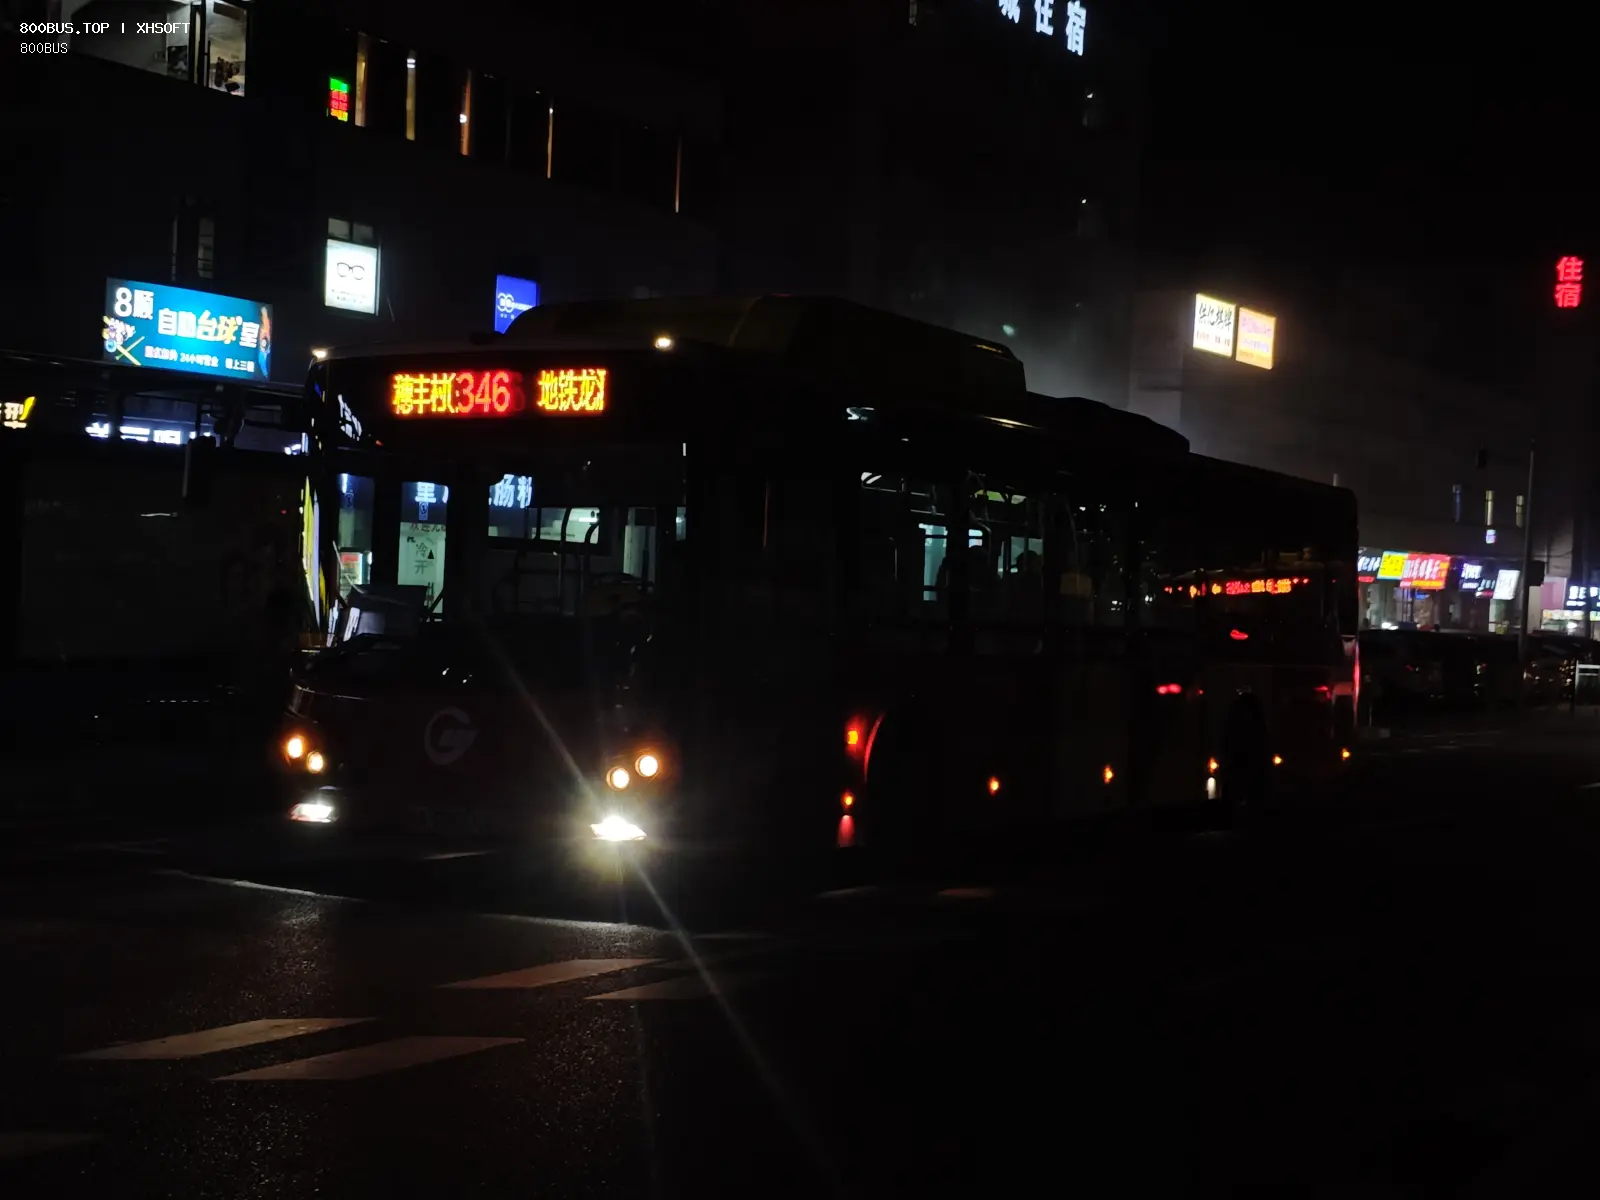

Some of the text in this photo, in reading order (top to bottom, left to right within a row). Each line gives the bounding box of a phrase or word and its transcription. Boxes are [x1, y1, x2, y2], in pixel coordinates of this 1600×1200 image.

[1555, 256, 1584, 308] 住宿
[158, 307, 260, 348] 自助台球室
[456, 371, 511, 413] 346
